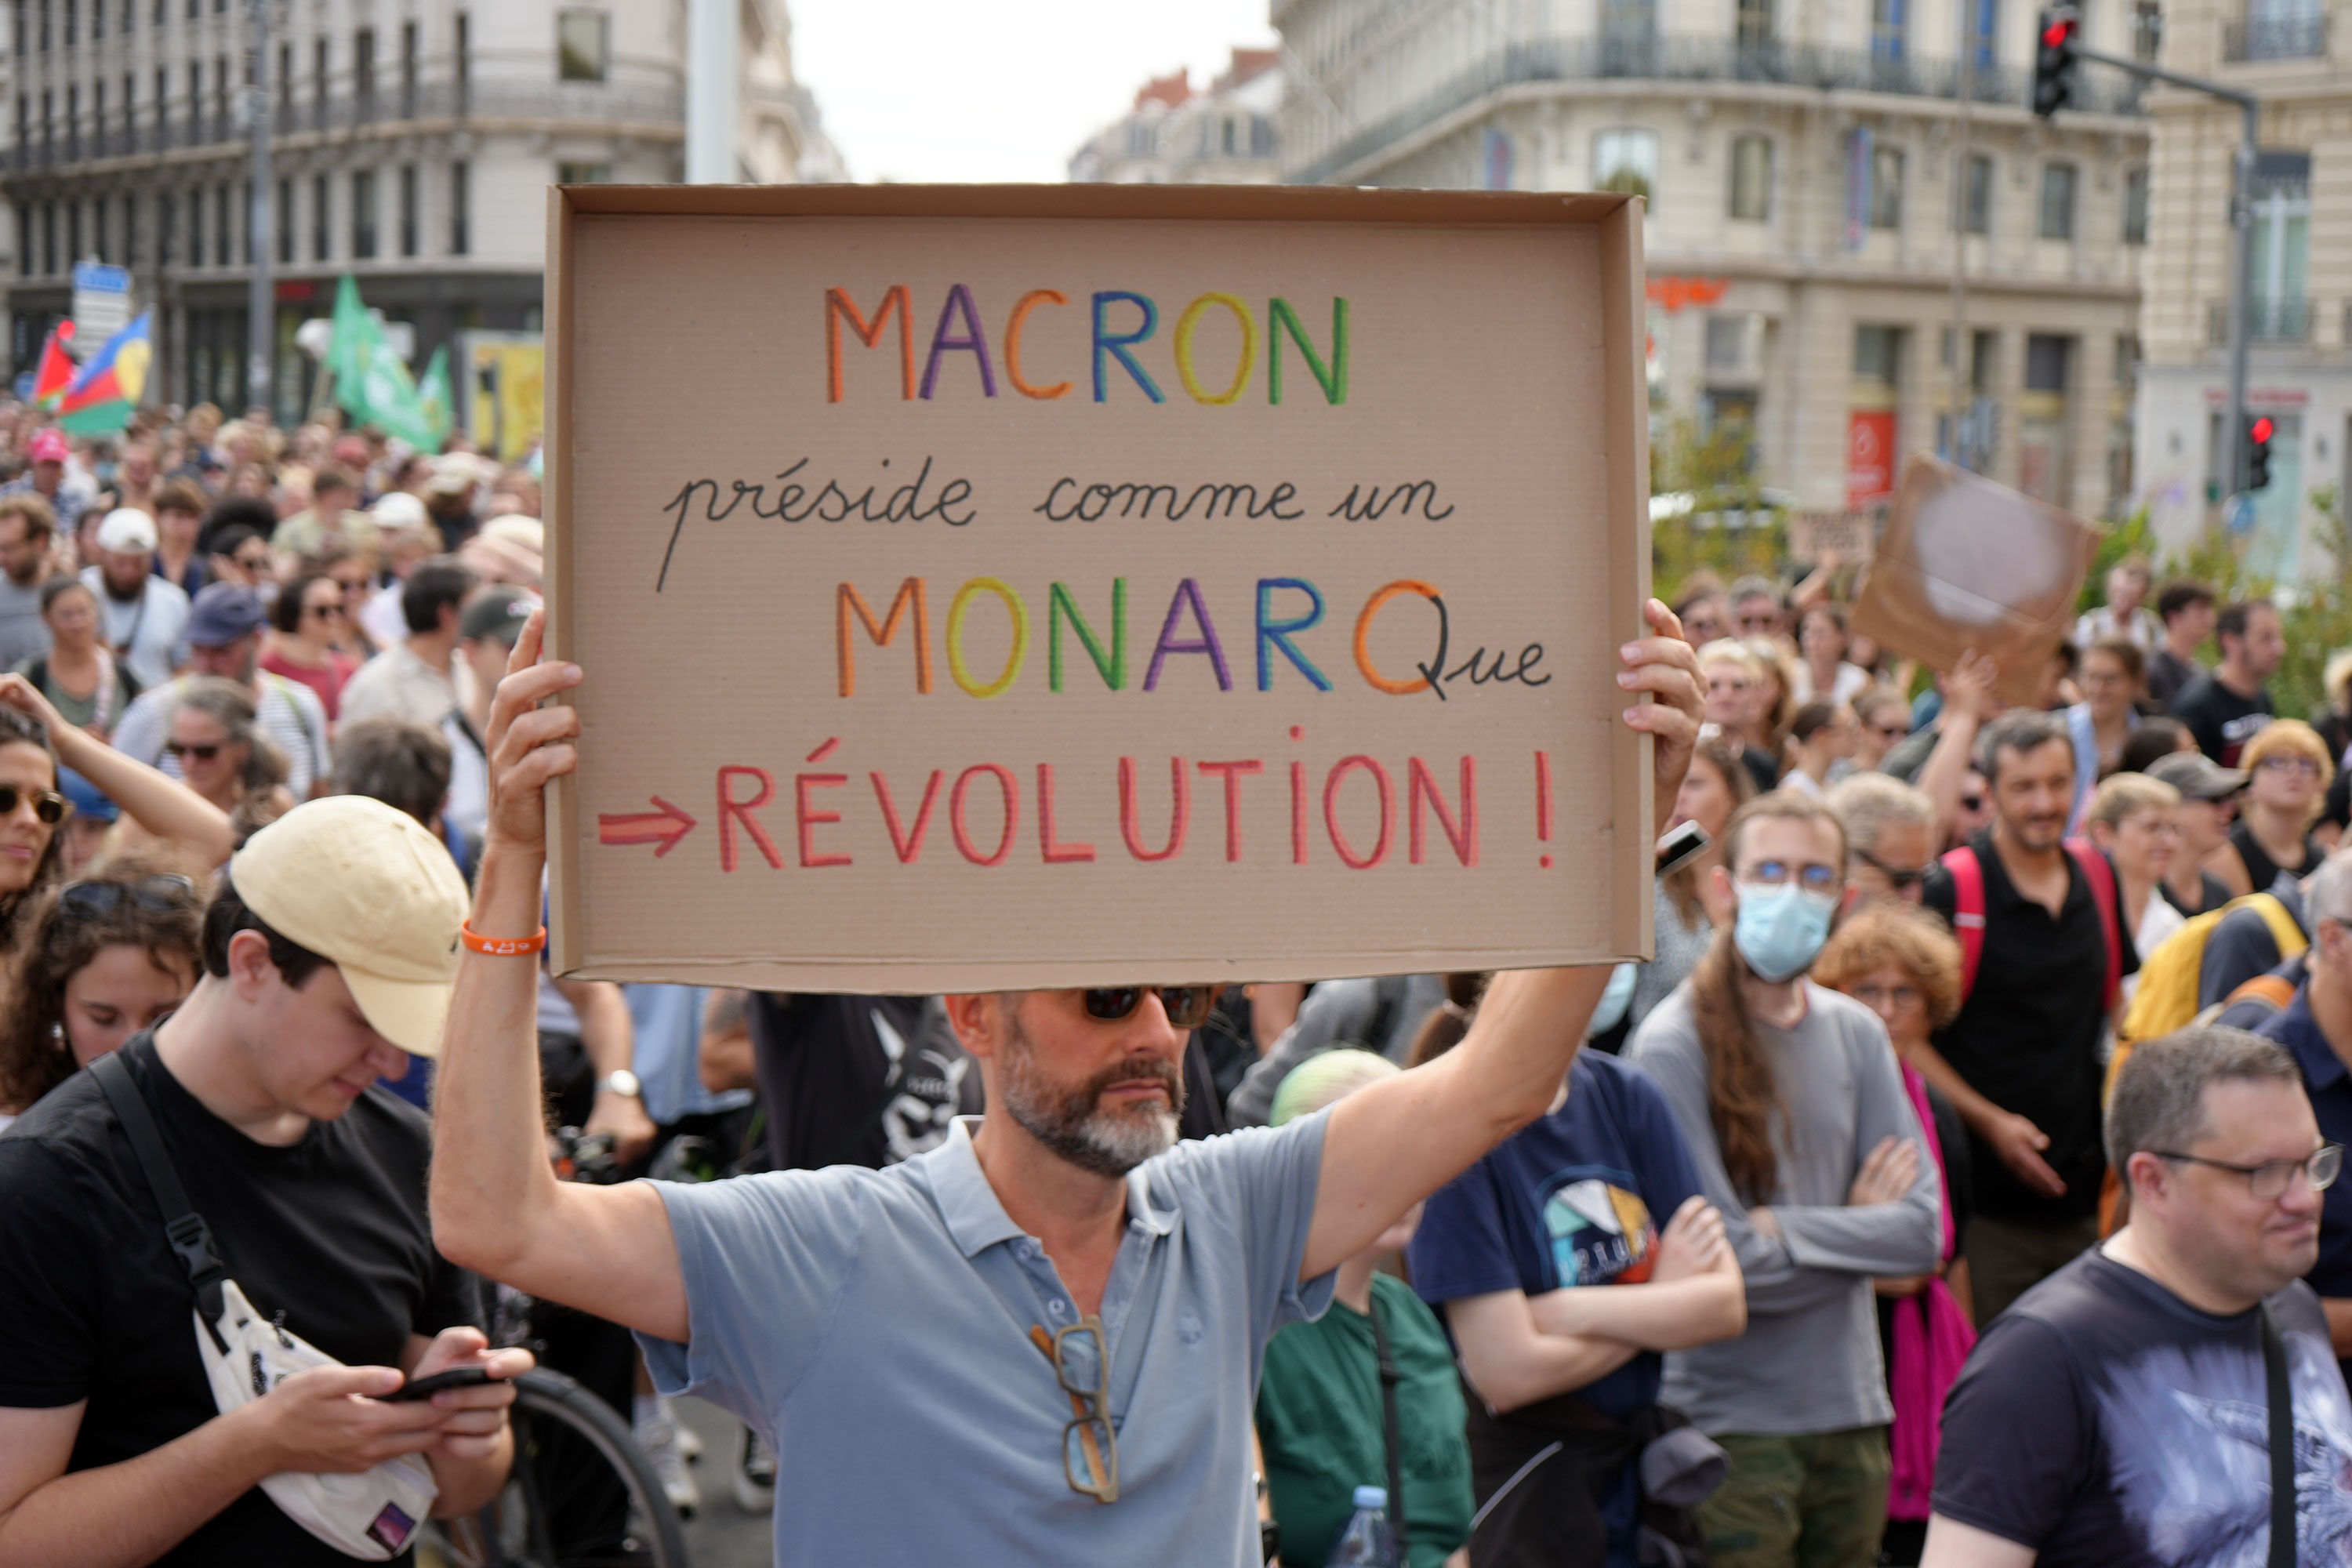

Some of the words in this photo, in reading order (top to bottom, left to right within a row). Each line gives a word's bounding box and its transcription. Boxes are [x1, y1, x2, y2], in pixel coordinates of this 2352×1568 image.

[824, 284, 1350, 407] MACRON
[656, 456, 978, 593] préside
[1033, 477, 1305, 523] comme
[1327, 479, 1457, 523] un
[835, 575, 1554, 702] MONARQue
